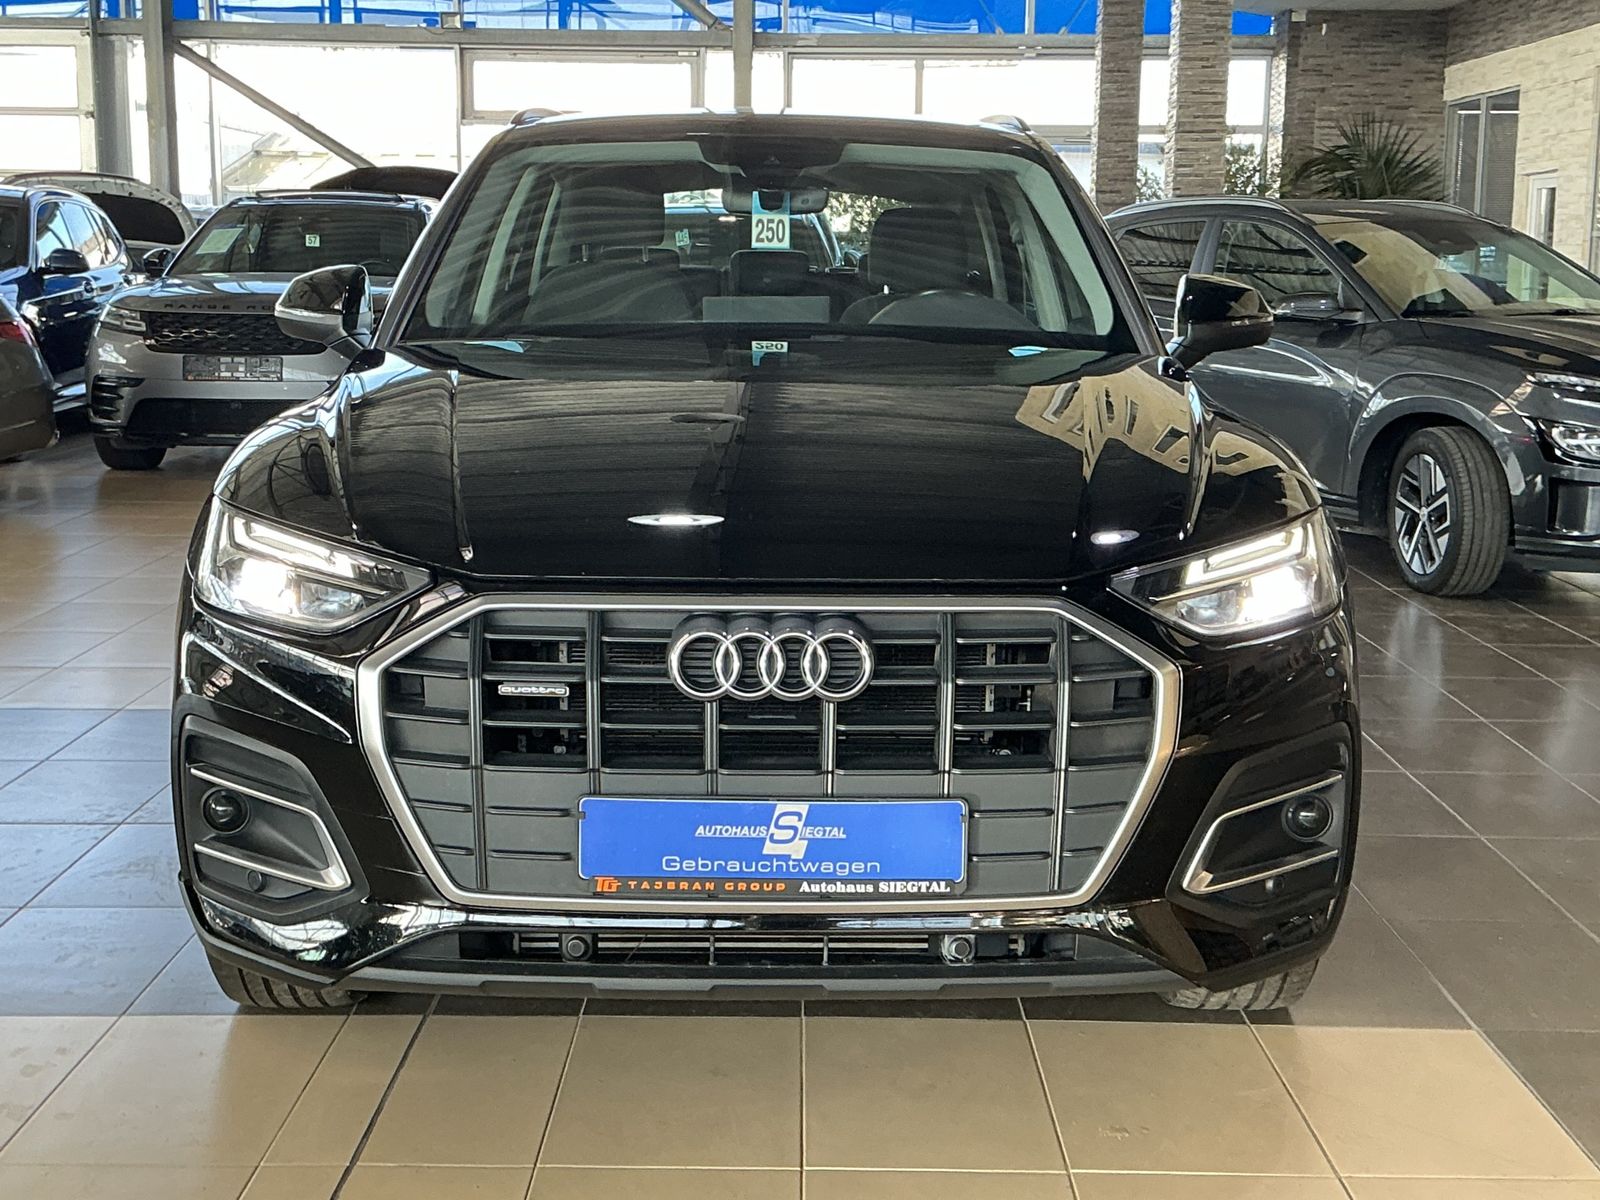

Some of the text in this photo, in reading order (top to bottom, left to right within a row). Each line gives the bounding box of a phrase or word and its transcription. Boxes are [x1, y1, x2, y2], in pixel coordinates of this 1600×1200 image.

[754, 218, 786, 243] 250
[307, 235, 317, 245] 57
[500, 685, 567, 695] quattro
[695, 824, 768, 838] AUTOHAUS
[661, 855, 881, 876] Gebrauchtwagen
[628, 880, 715, 892] TAJERAN
[724, 882, 786, 892] GROUP
[799, 880, 874, 893] Autohaus
[878, 881, 951, 893] SIEGTAL
